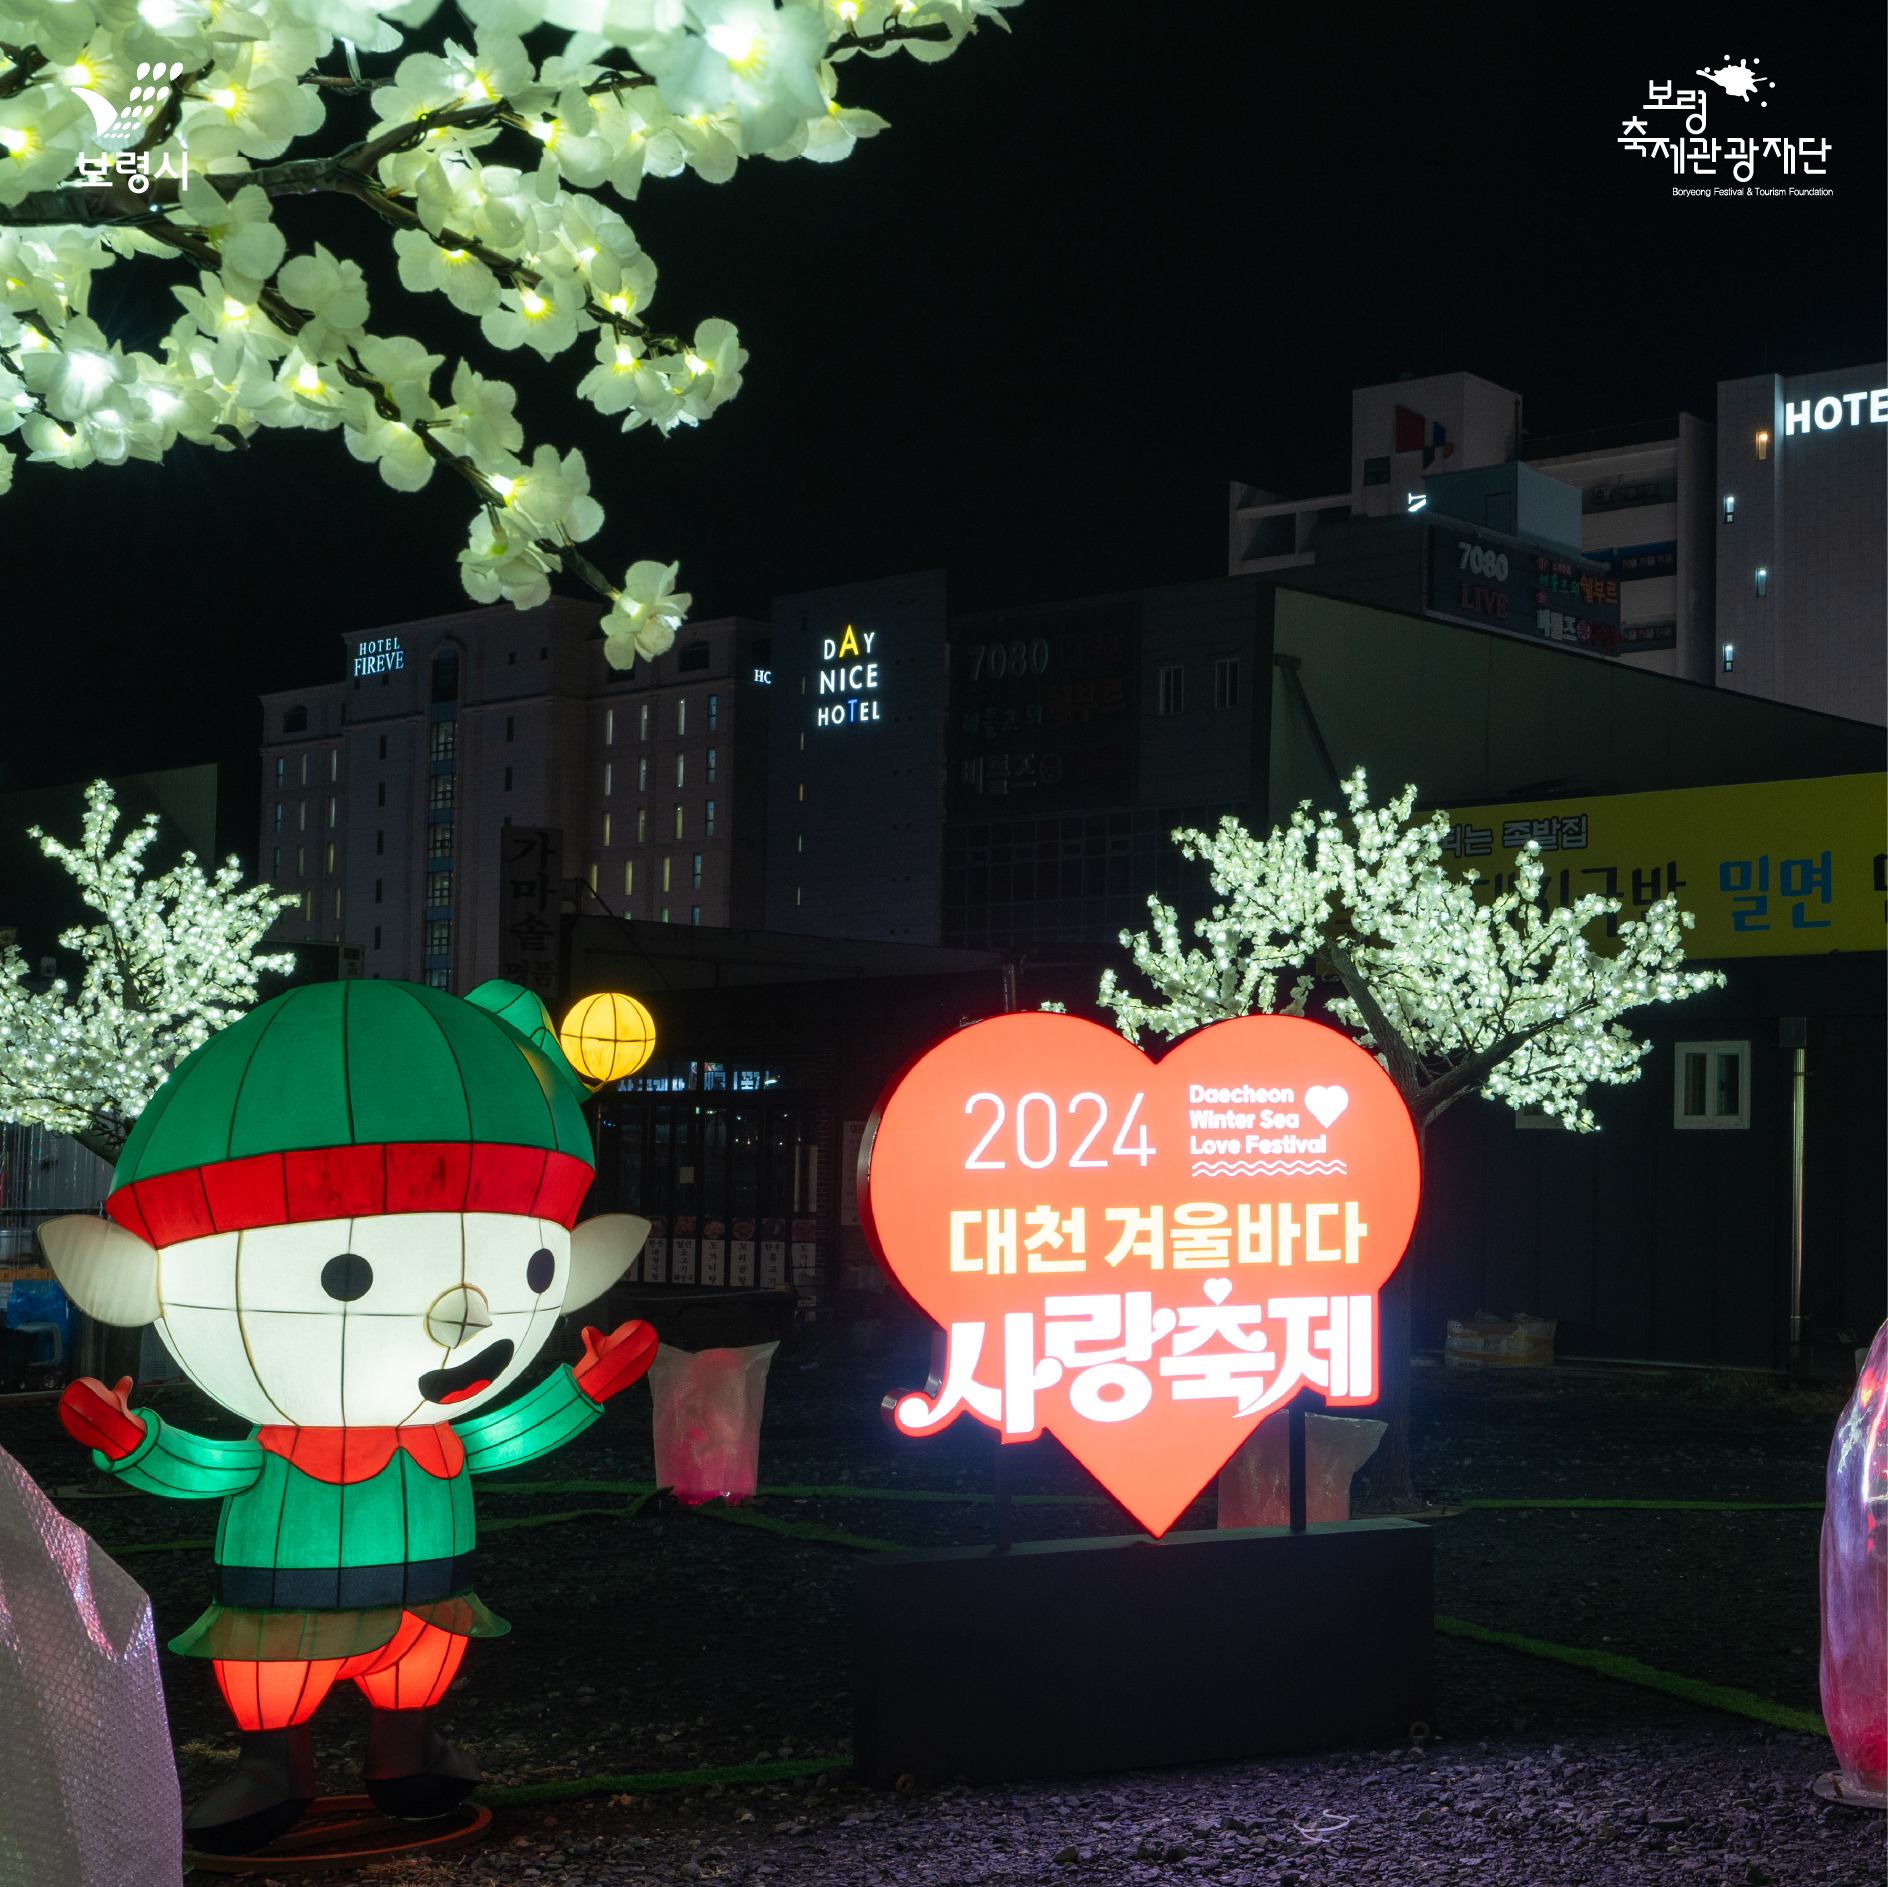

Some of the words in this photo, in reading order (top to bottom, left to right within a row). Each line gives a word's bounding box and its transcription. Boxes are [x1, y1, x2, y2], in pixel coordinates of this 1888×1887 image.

[1458, 541, 1509, 582] 7080
[1460, 583, 1508, 619] LIVE
[359, 637, 400, 656] HOTEL
[824, 624, 875, 660] DAY
[968, 636, 1049, 681] 7080
[353, 651, 404, 676] FIREVE
[820, 664, 878, 694] NICE
[818, 699, 880, 726] HOTEL
[509, 832, 556, 950] 가마솥
[1719, 850, 1832, 932] 밀면
[1189, 1084, 1295, 1104] Daecheon
[965, 1092, 1156, 1169] 2024
[1189, 1110, 1256, 1129] Winter
[1259, 1110, 1300, 1128] Sea
[1190, 1136, 1241, 1155] Love
[1245, 1134, 1327, 1154] Festival
[950, 1205, 1086, 1275] 대천
[1104, 1201, 1368, 1270] 겨울바다
[898, 1291, 1373, 1434] 사랑축제
